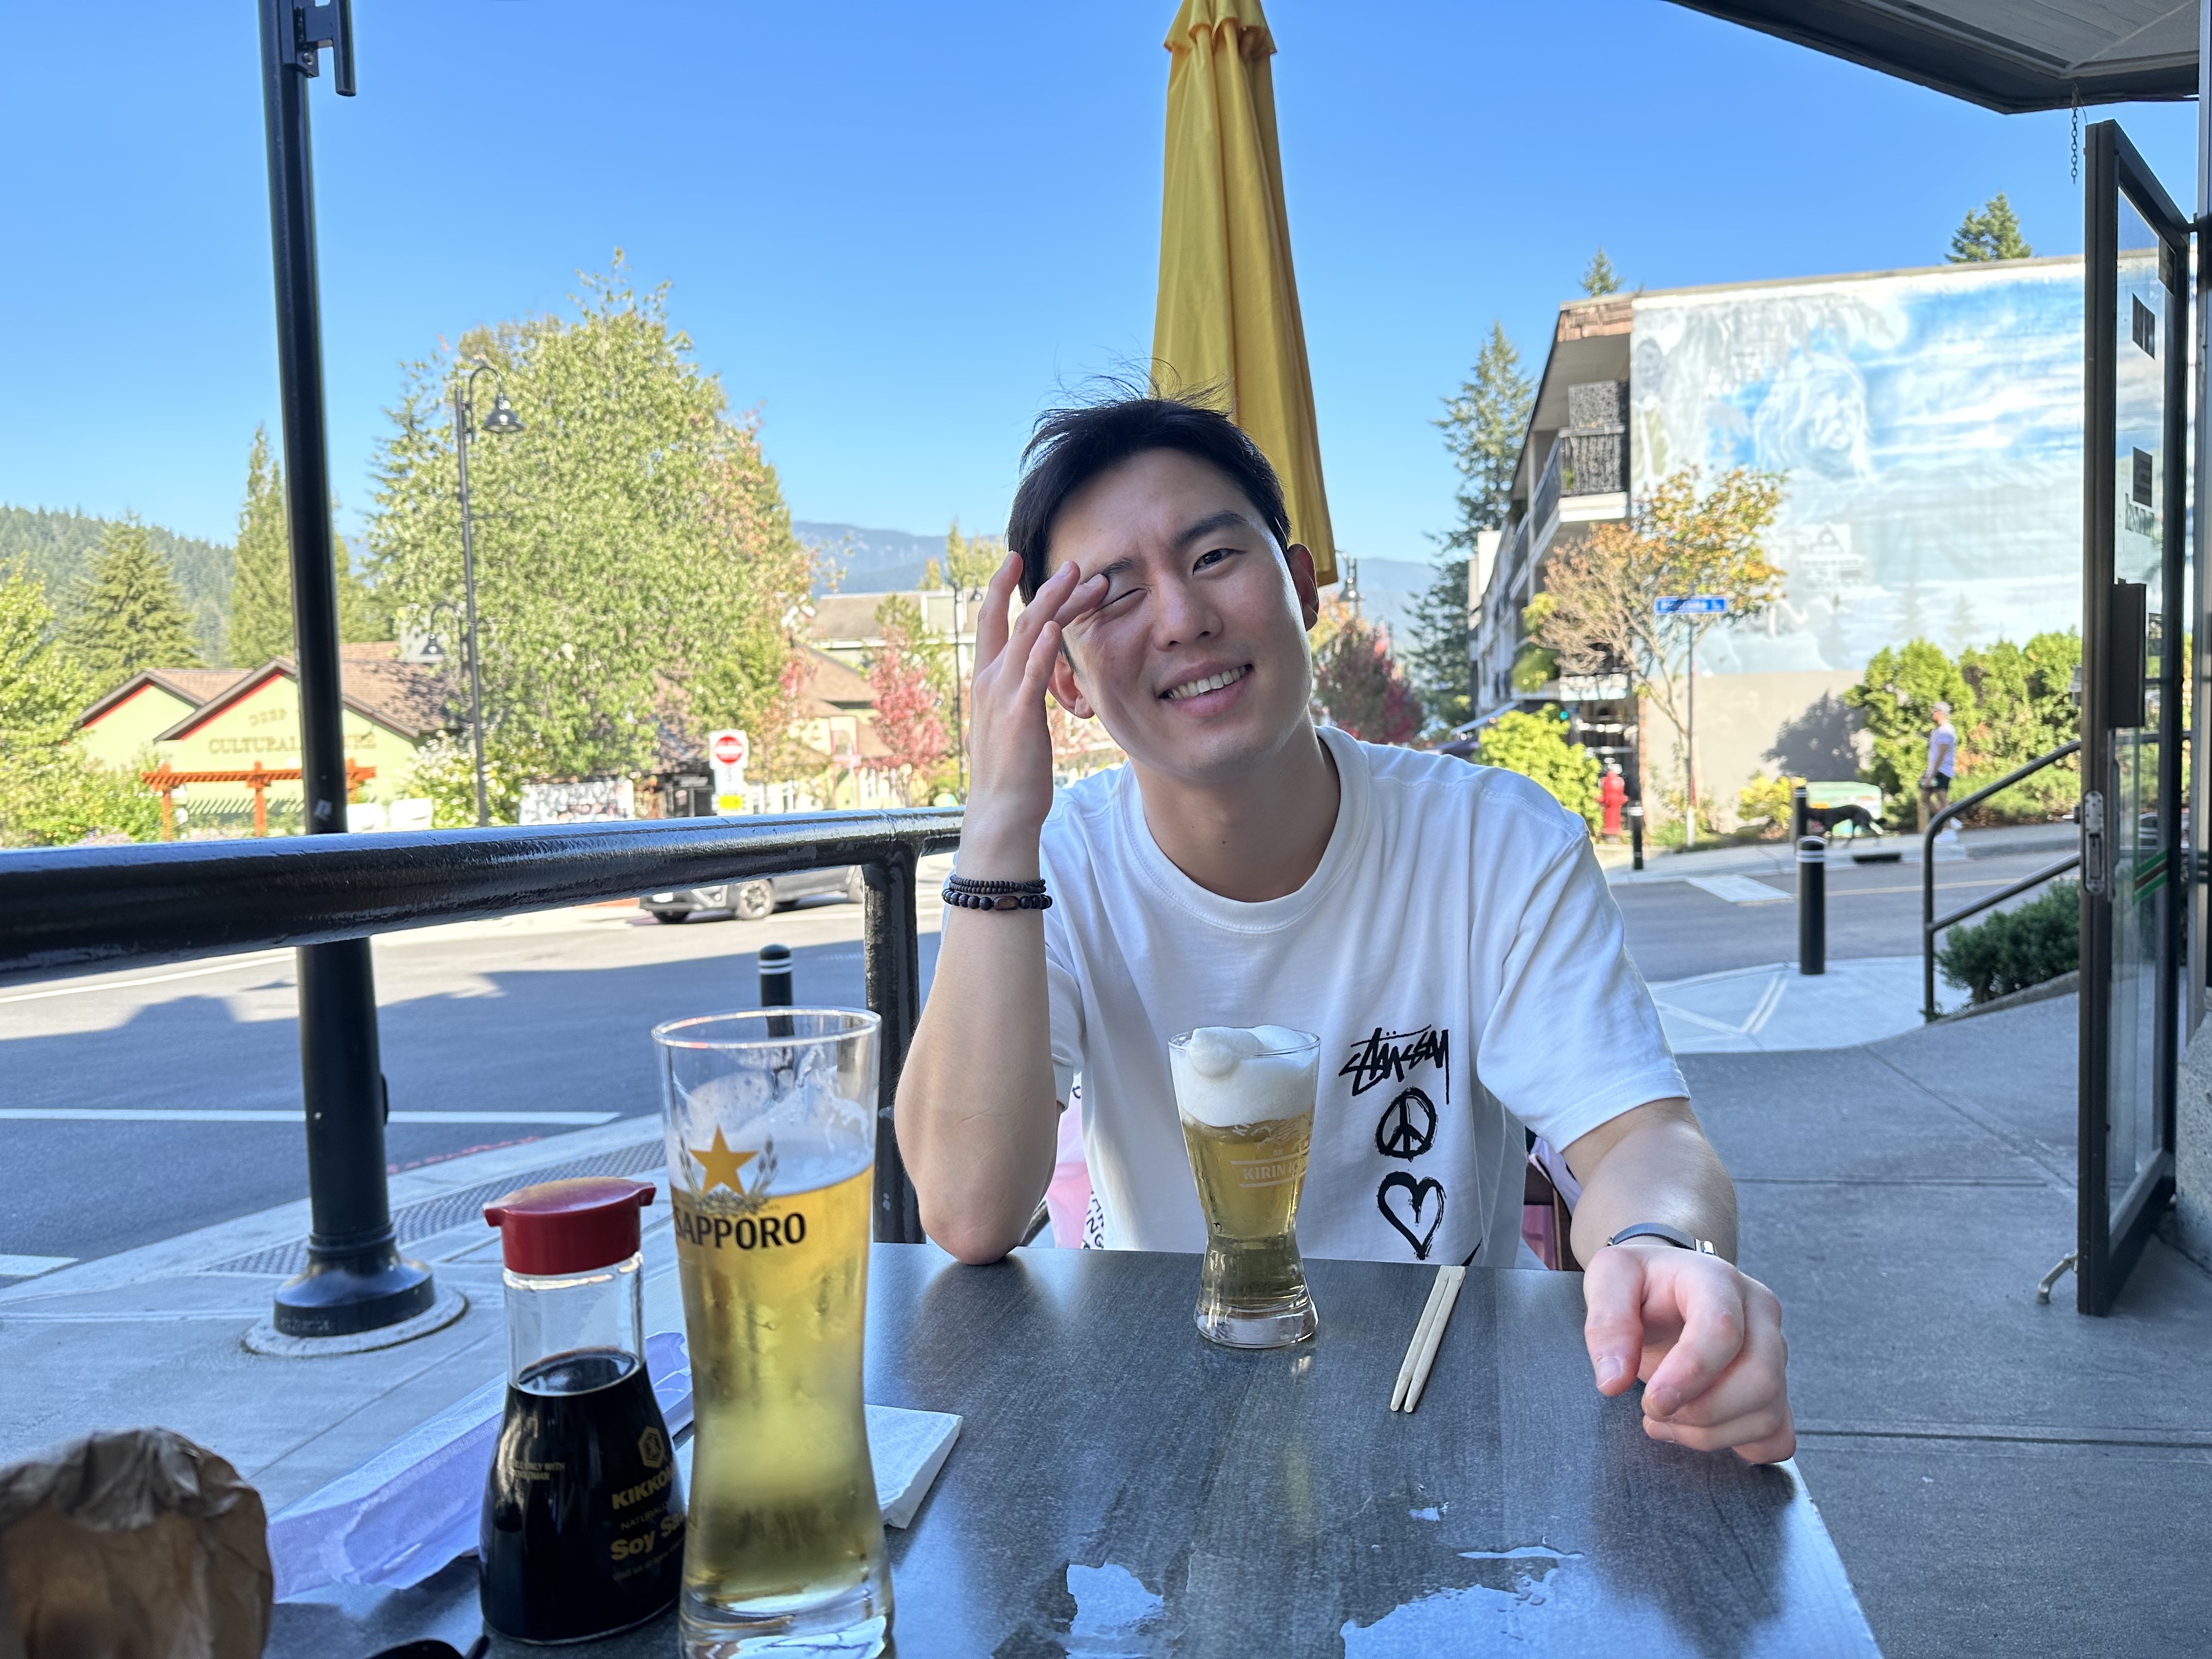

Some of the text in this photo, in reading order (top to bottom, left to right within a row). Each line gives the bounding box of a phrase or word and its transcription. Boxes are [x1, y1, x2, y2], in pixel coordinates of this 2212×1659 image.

[1243, 1164, 1285, 1180] KIRIN
[674, 1208, 806, 1250] SAPPORO
[610, 1530, 656, 1561] Soy
